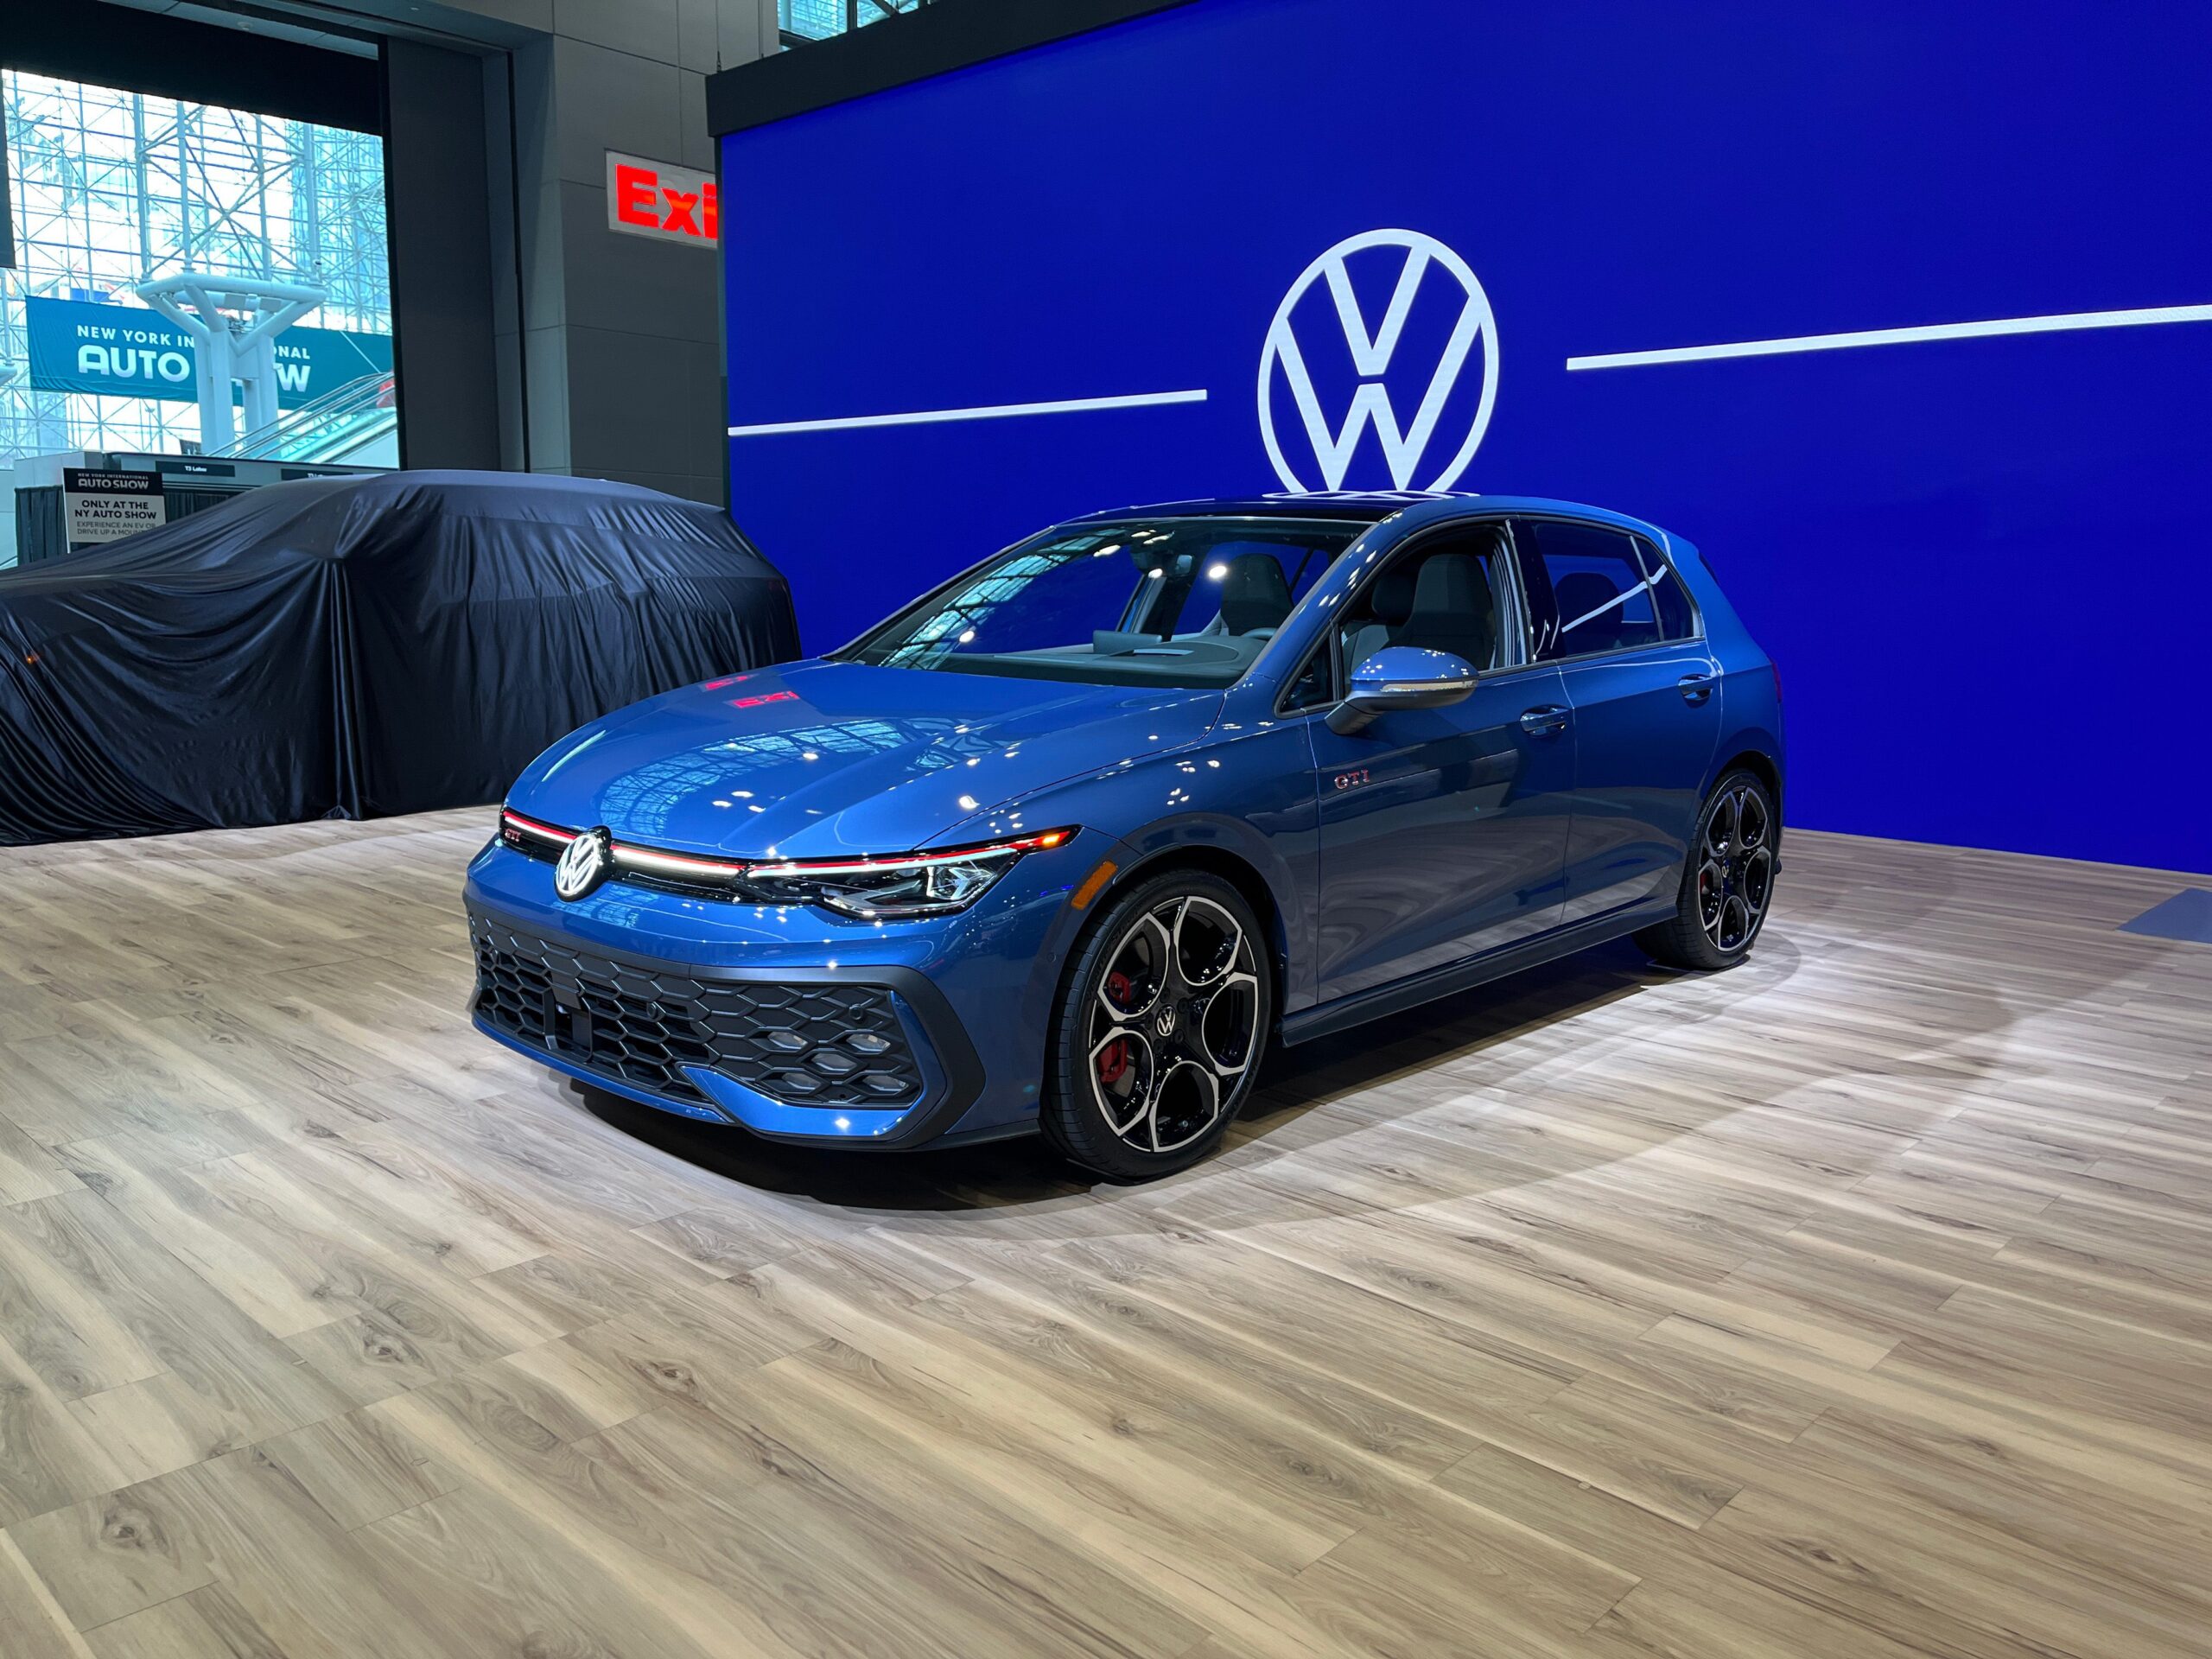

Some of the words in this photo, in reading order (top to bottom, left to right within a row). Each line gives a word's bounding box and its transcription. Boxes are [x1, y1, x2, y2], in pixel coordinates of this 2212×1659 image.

[615, 163, 718, 240] Exi
[77, 325, 116, 340] NEW
[123, 329, 171, 346] YORK
[78, 344, 190, 383] AUTO
[78, 478, 112, 488] AUTO
[112, 480, 149, 489] SHOW
[81, 499, 110, 508] ONLY
[128, 501, 149, 510] THE
[92, 510, 122, 518] AUTO
[1334, 768, 1370, 790] GTI
